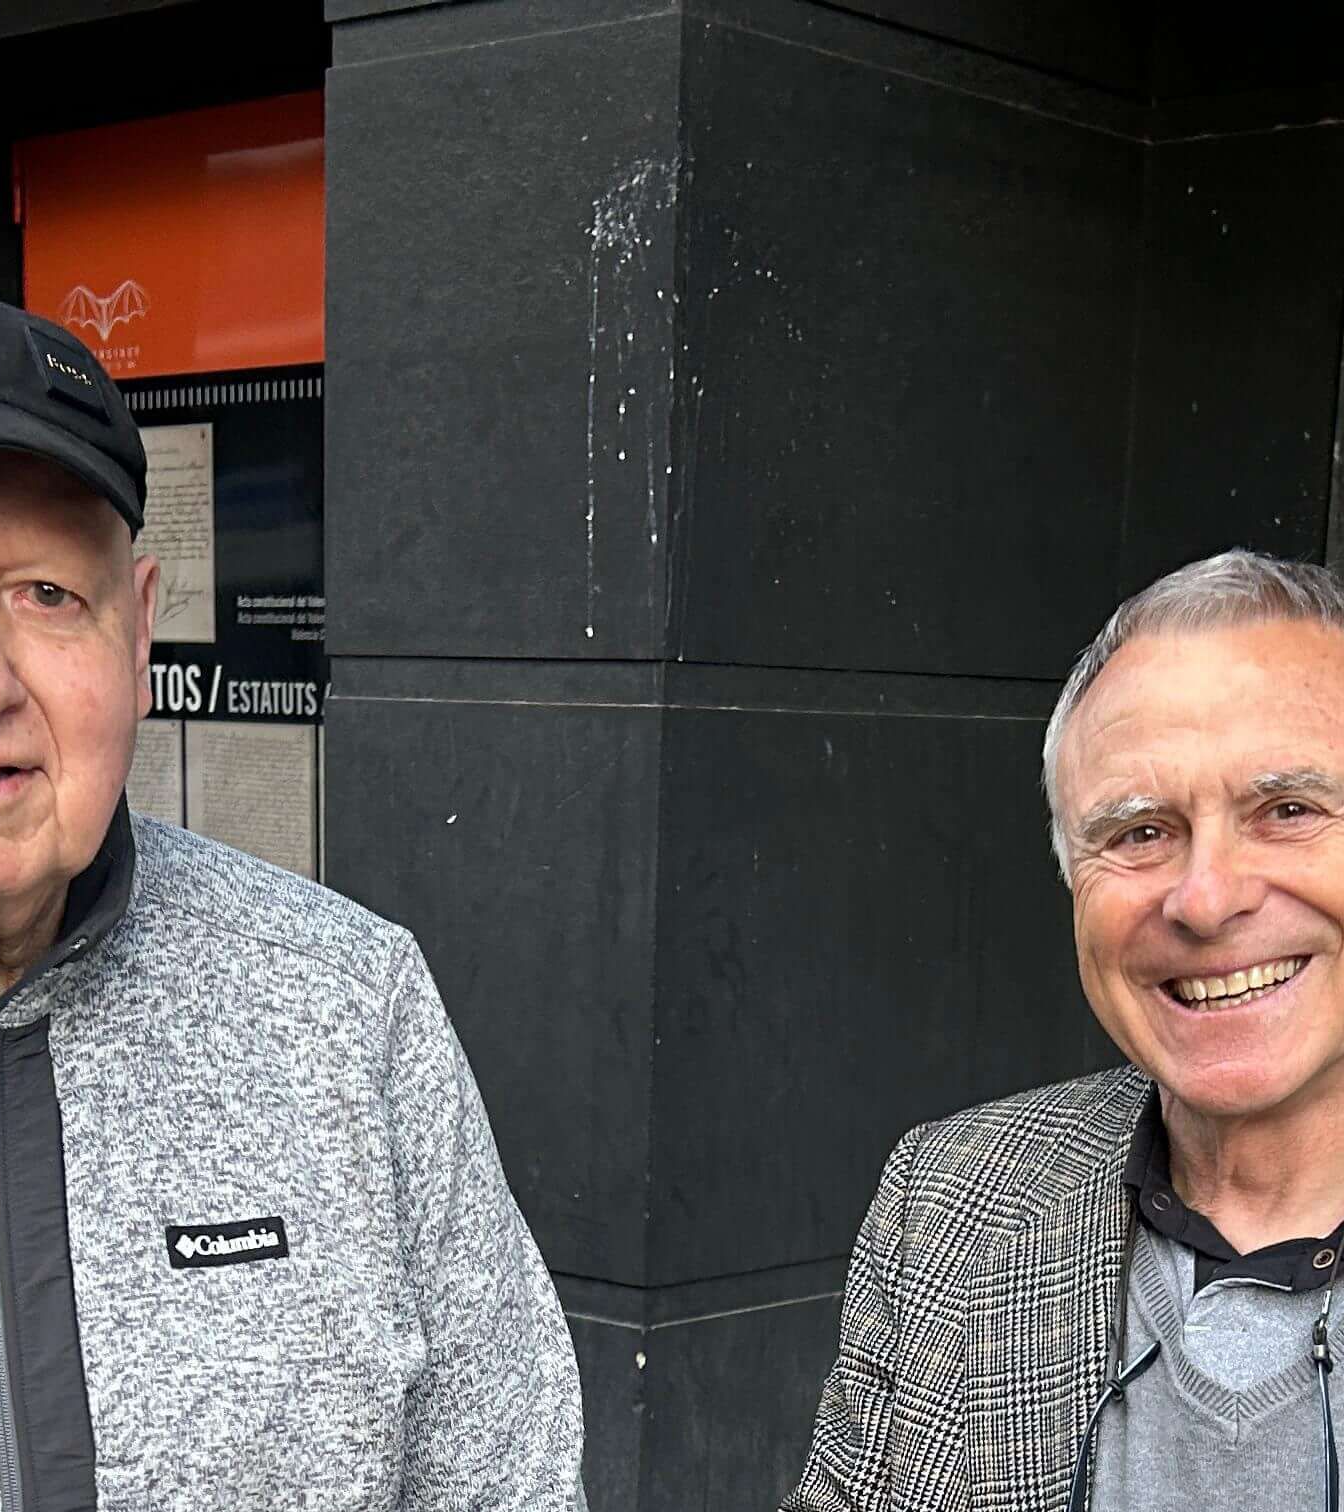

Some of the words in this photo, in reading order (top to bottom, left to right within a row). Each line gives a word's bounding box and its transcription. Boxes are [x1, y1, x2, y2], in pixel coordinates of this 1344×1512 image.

[147, 663, 202, 712] TOS
[228, 681, 318, 716] ESTATUTS
[194, 1228, 280, 1256] Columbia
